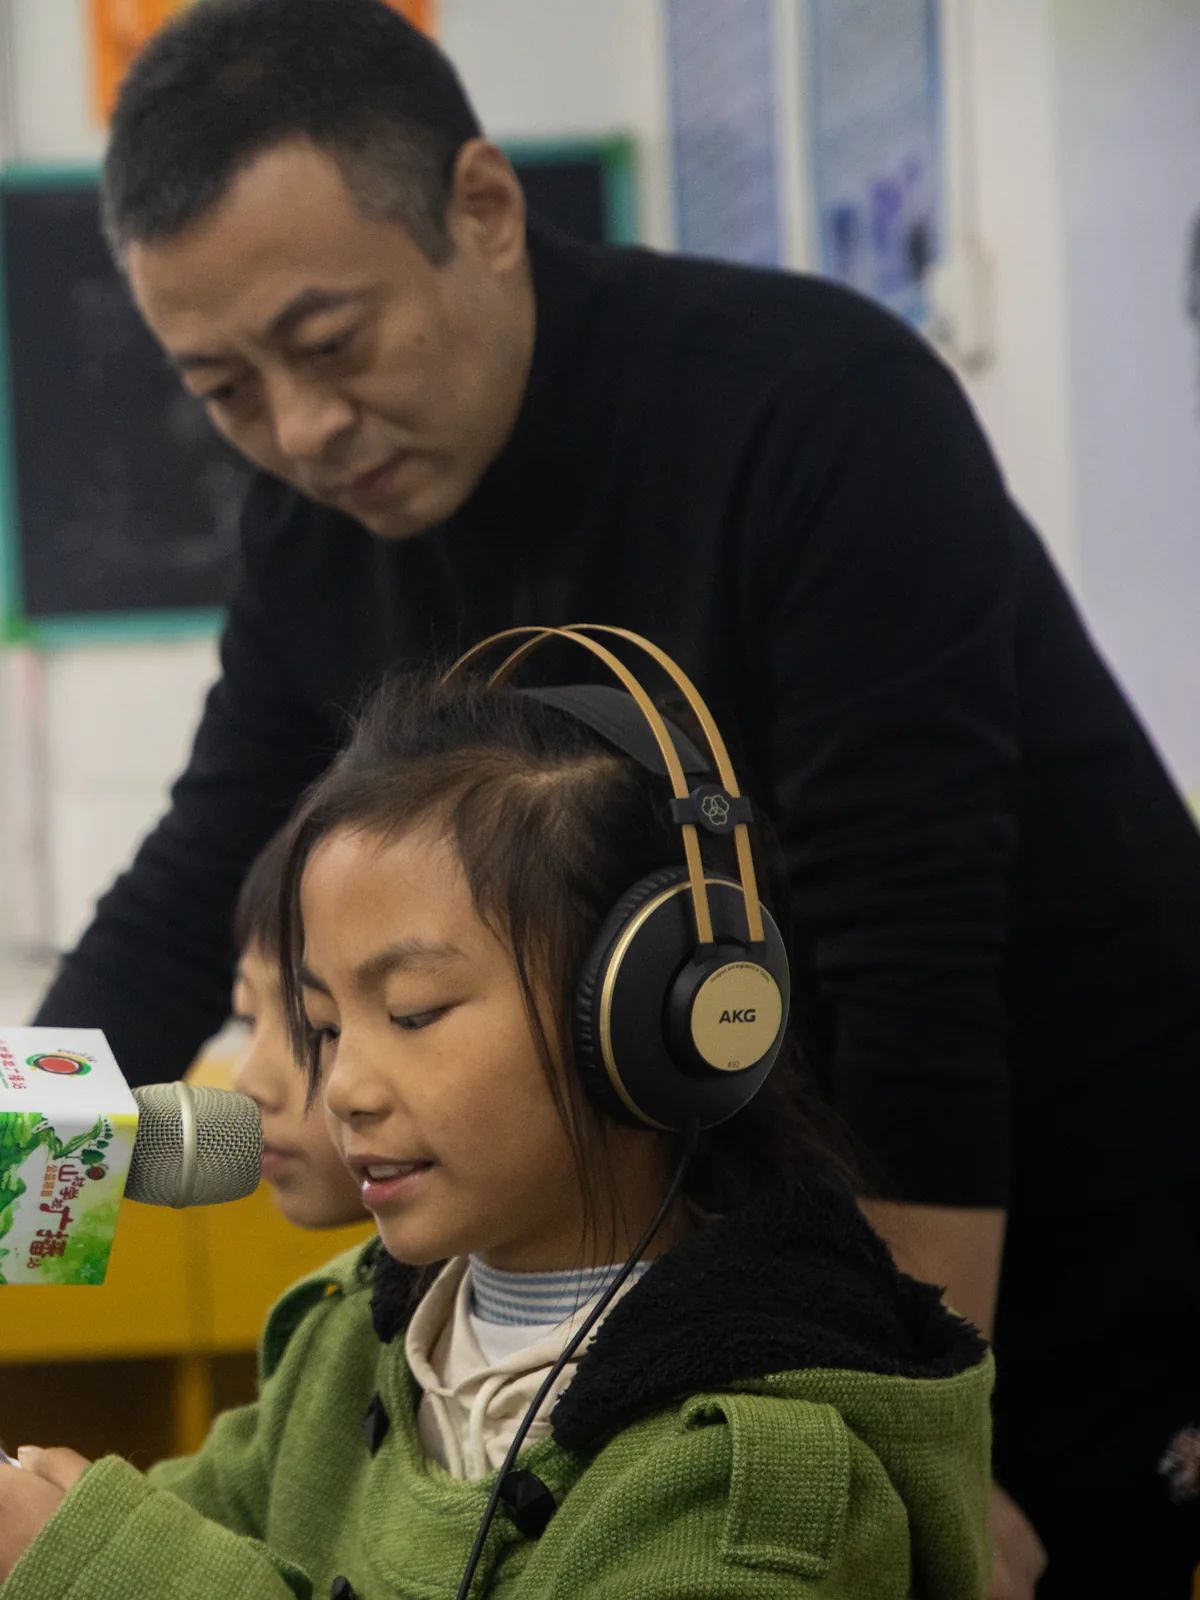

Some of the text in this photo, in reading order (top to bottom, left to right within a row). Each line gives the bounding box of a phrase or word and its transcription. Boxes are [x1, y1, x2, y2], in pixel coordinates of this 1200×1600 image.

[719, 1009, 756, 1024] AKG
[26, 1164, 86, 1269] 山村学校广播站
